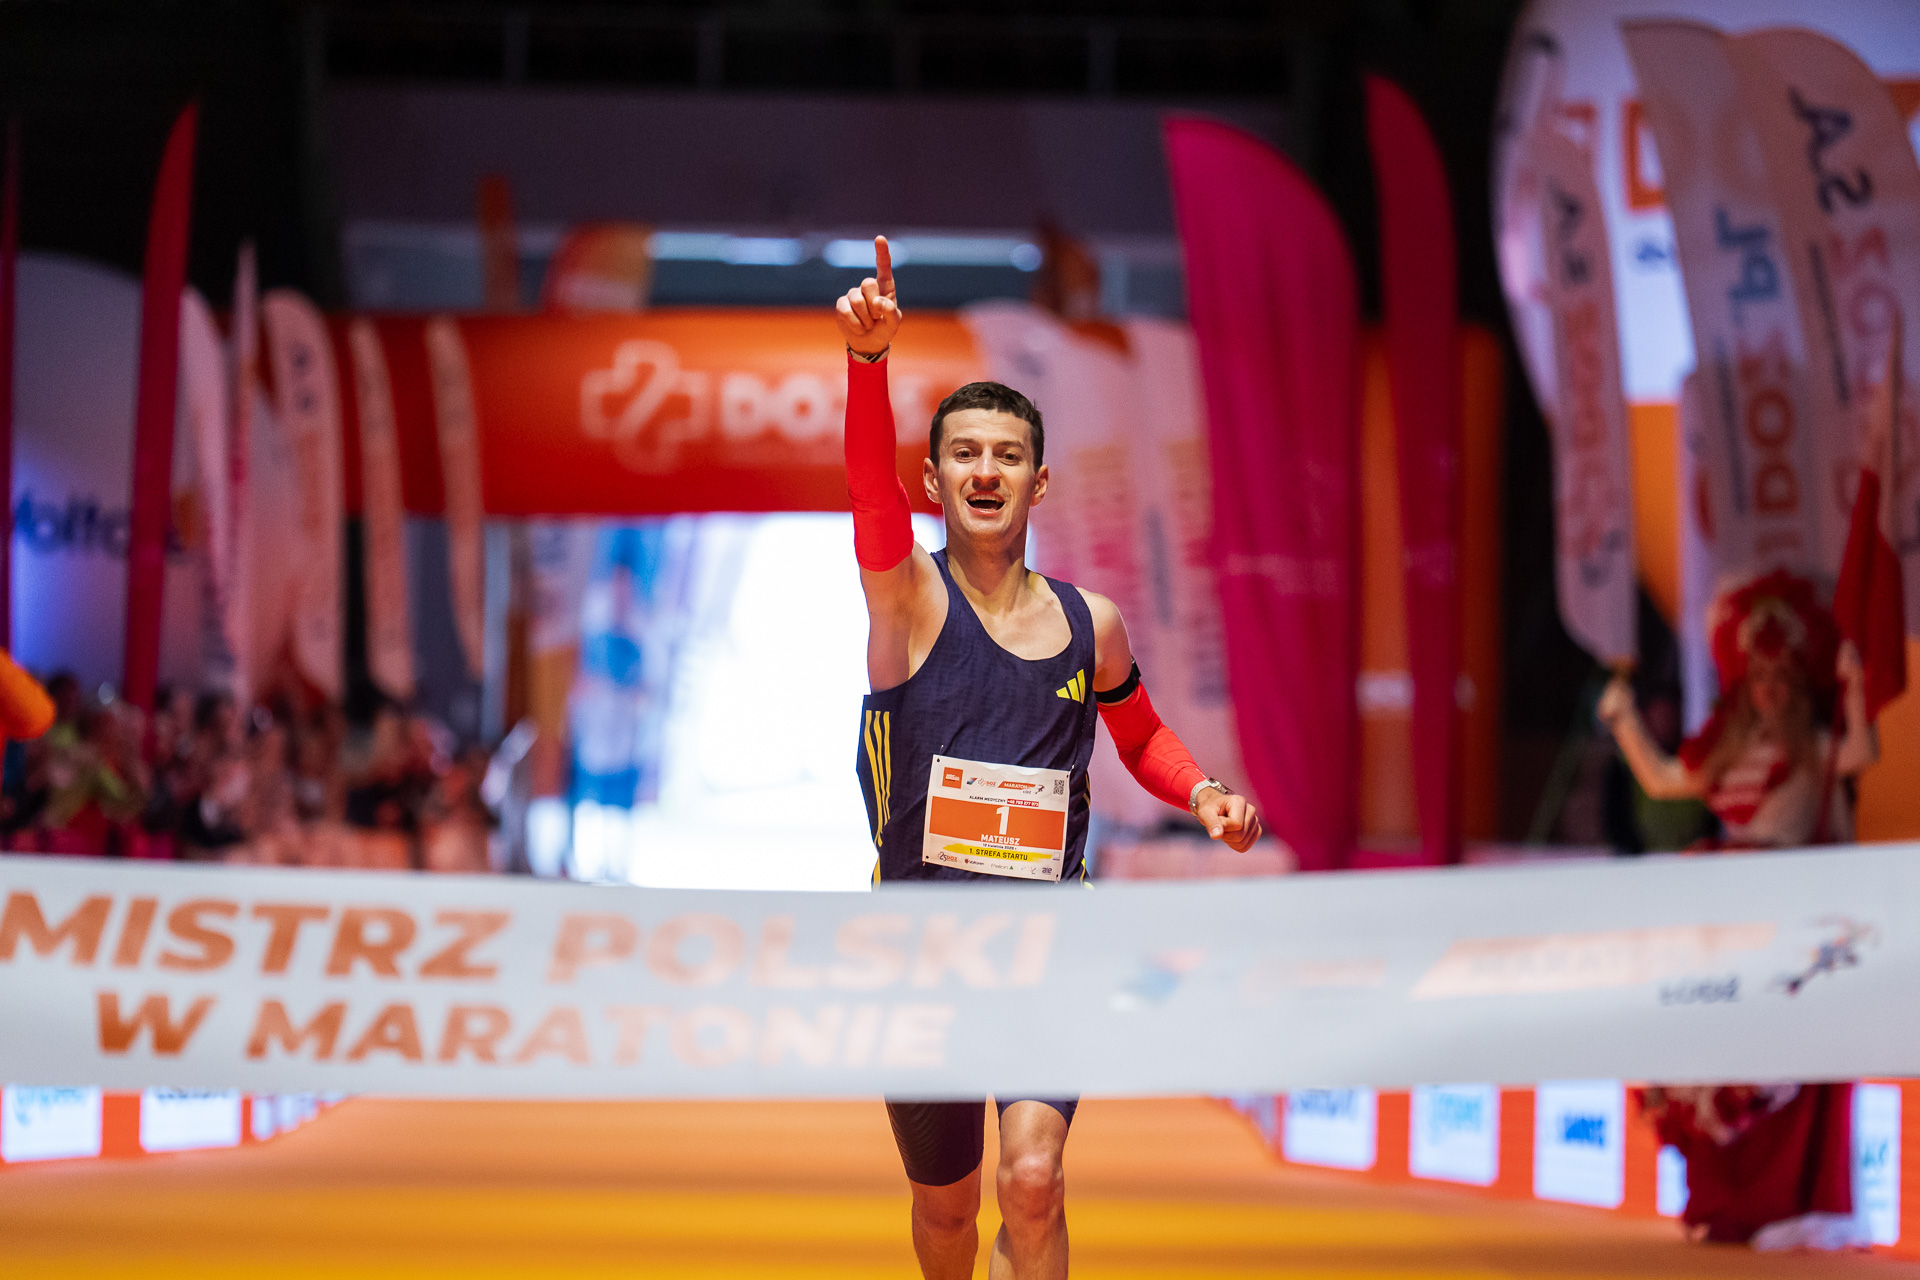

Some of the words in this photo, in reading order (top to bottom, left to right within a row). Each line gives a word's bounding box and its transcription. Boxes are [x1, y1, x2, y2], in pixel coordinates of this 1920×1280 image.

[996, 806, 1010, 835] 1
[981, 834, 1020, 845] MATEUSZ
[975, 849, 1001, 857] STREFA
[1002, 852, 1028, 860] STARTU
[0, 888, 513, 980] MISTRZ
[545, 910, 1059, 990] POLSKI
[95, 990, 215, 1057] W
[244, 997, 956, 1069] MARATONIE
